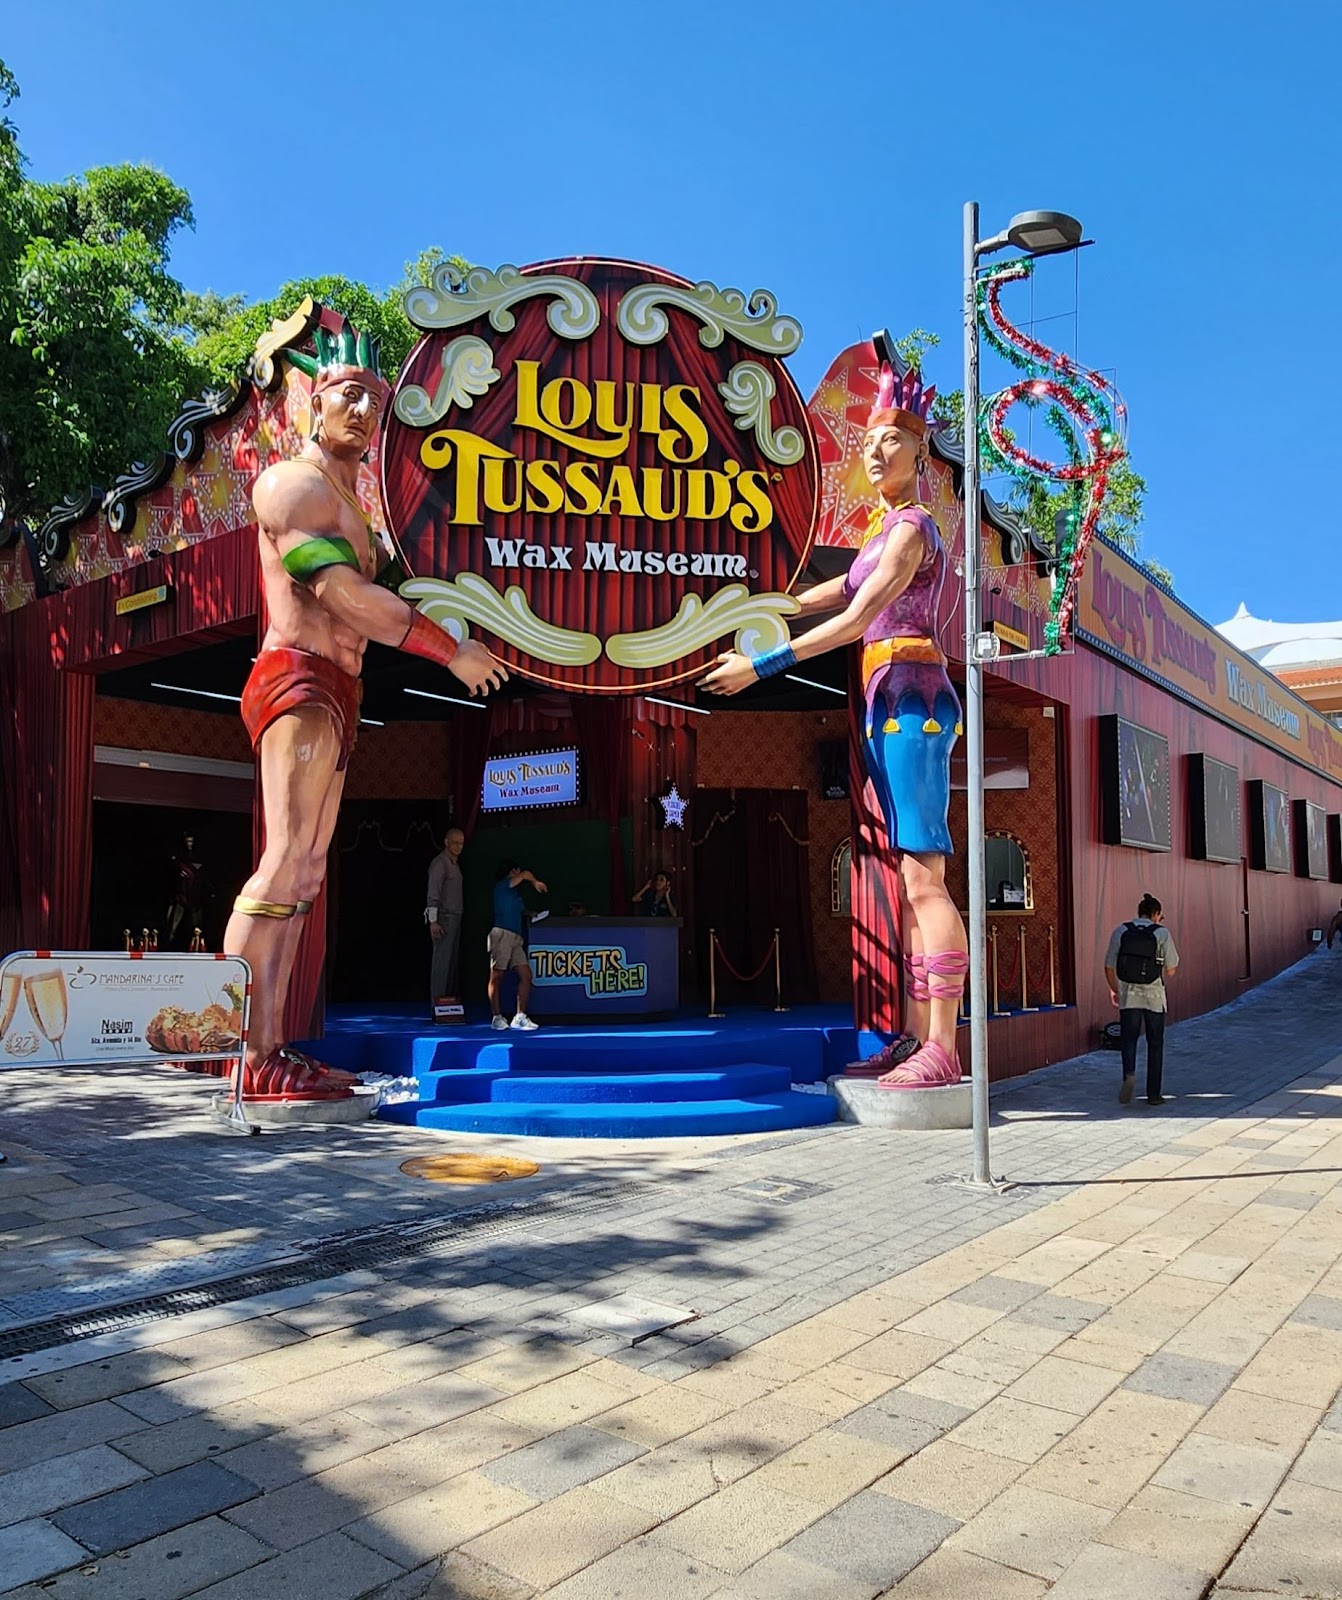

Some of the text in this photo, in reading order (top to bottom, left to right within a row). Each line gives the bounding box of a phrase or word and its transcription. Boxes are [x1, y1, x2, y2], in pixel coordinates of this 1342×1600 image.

[513, 359, 709, 463] LOUIS
[420, 428, 774, 533] TUSSAUD'S
[484, 537, 748, 578] Wax Museum
[1225, 658, 1255, 714] Wax
[1255, 682, 1301, 741] Museum
[489, 760, 571, 786] LOUIS TUSSAUD'S
[500, 784, 560, 798] Wax Museum
[530, 949, 623, 978] TICKETS
[163, 974, 184, 984] CAFE
[590, 965, 646, 994] HERE!
[102, 1019, 133, 1030] Nasim
[15, 1036, 31, 1049] 27
